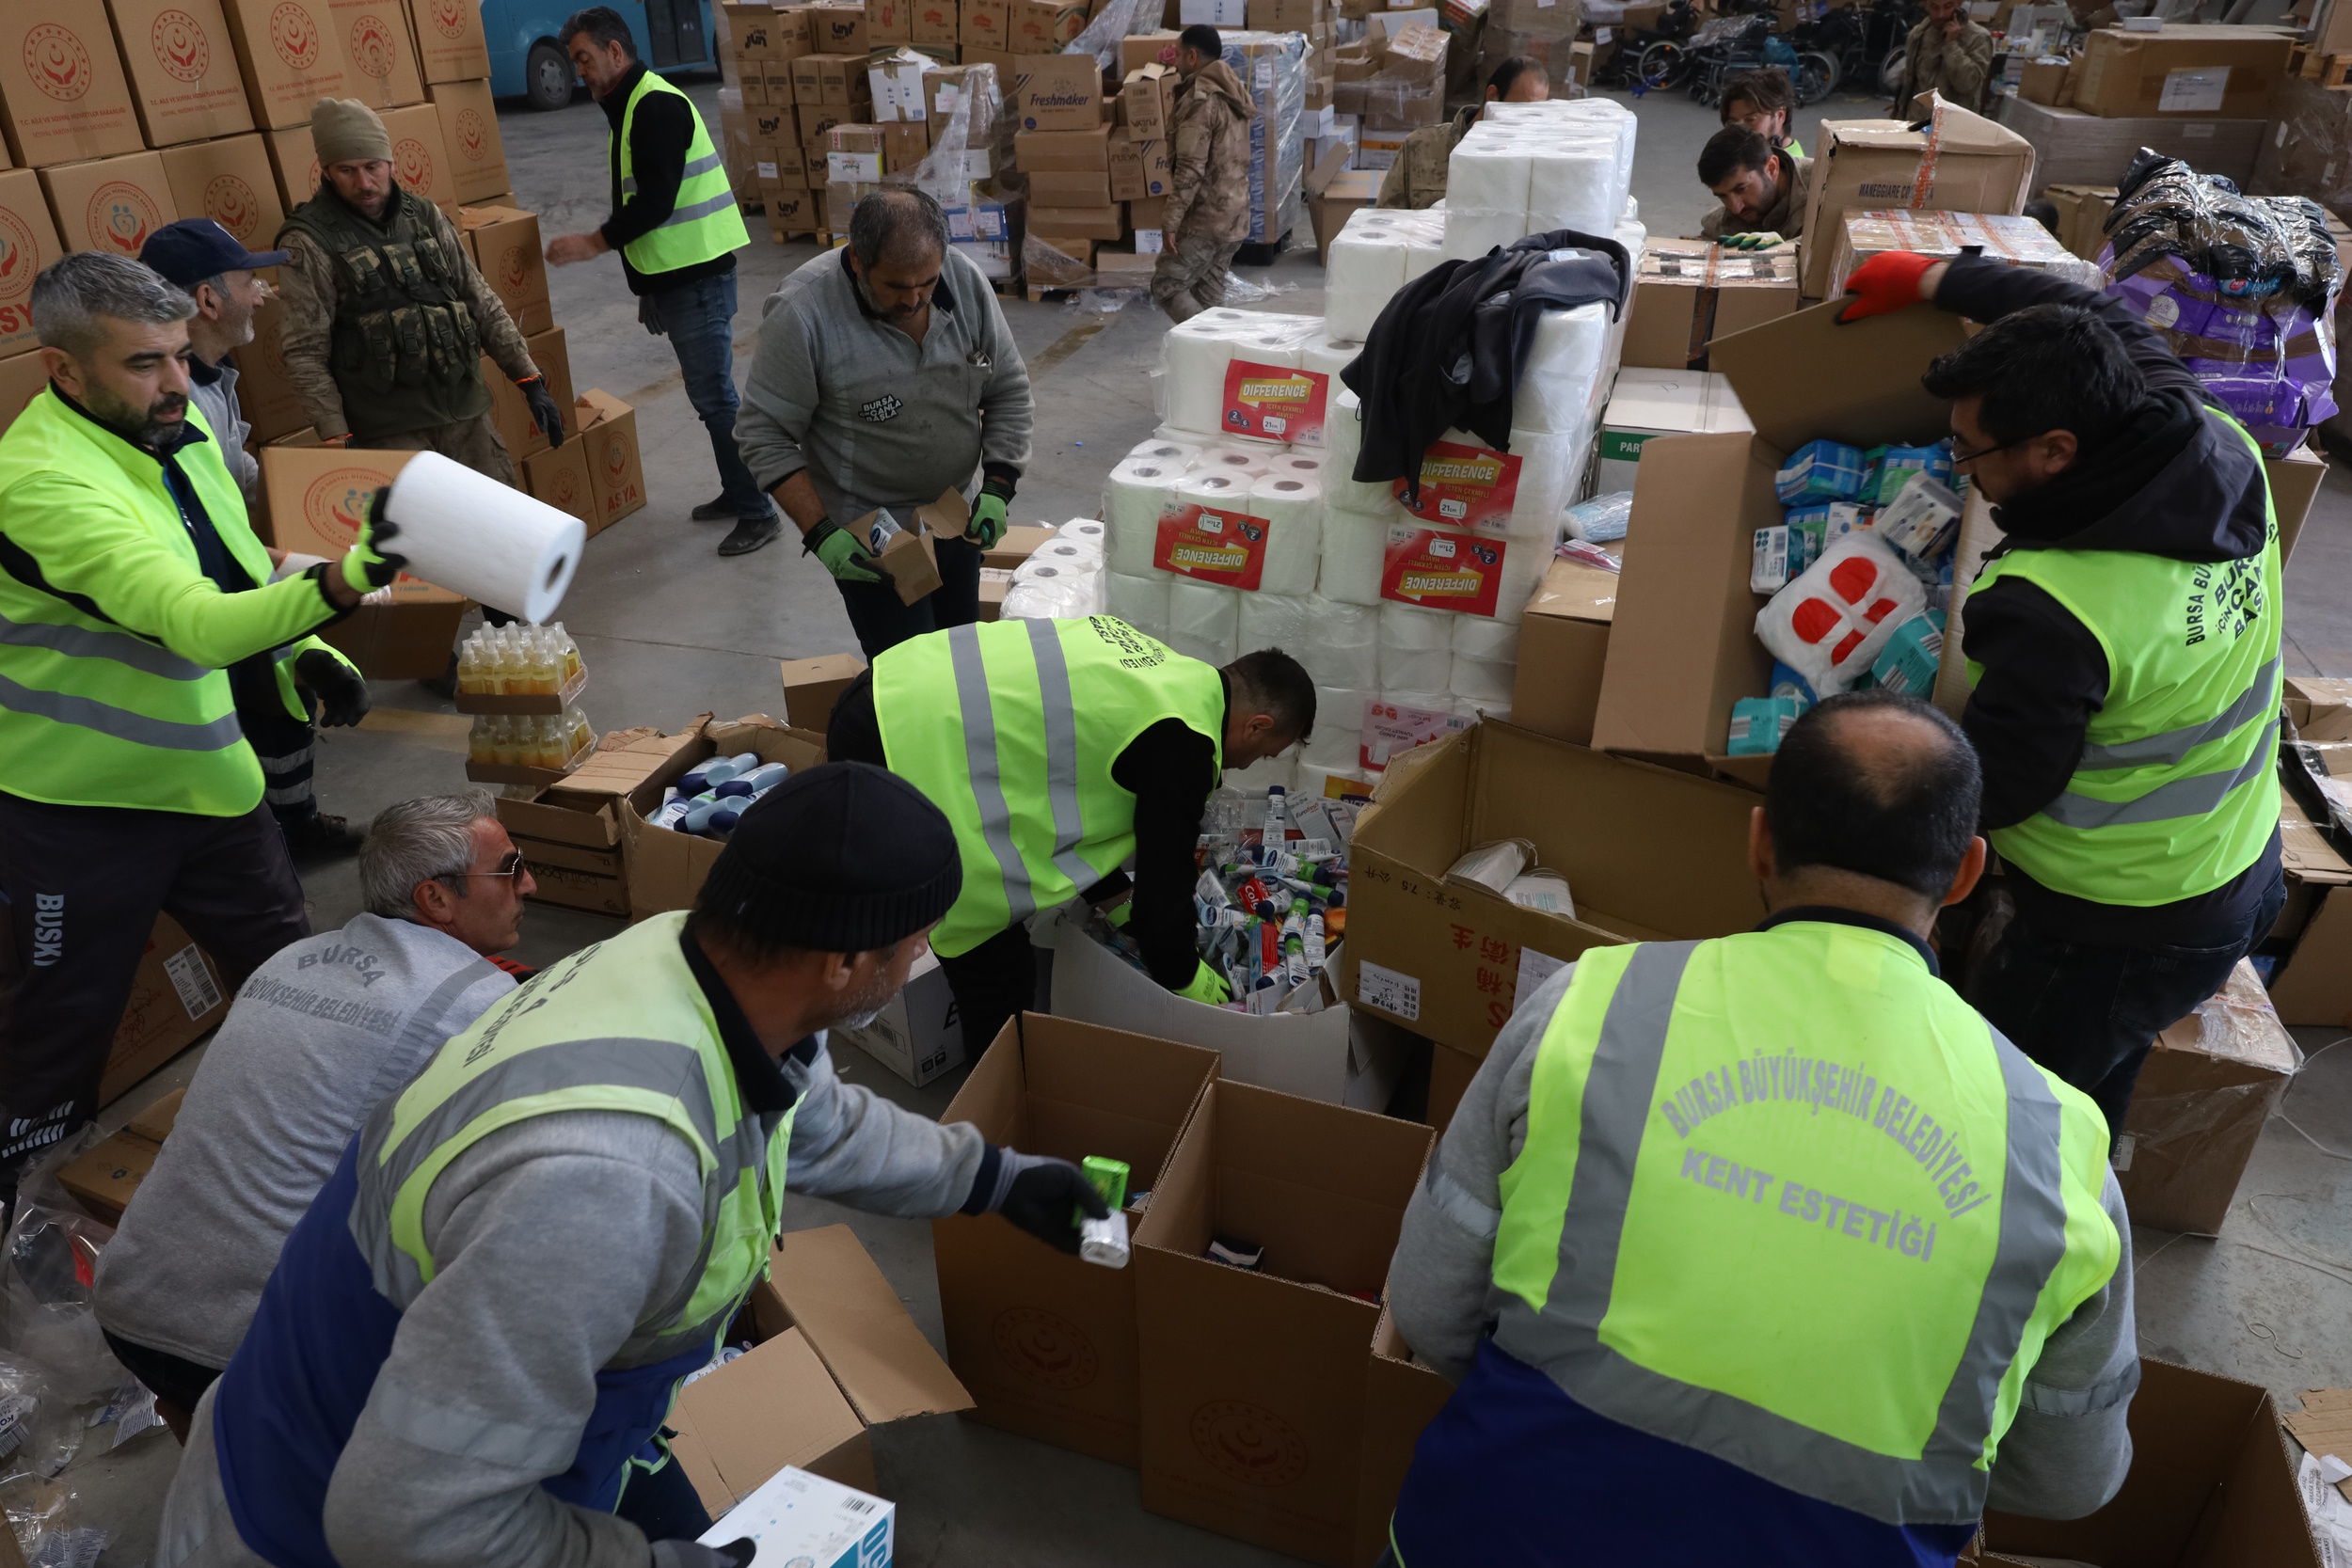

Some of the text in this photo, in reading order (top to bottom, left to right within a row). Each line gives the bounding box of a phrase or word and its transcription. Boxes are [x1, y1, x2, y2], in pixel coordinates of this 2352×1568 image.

[1030, 93, 1089, 106] Freshmaker
[1859, 183, 1900, 198] MANEGGIARE
[1243, 385, 1307, 398] DIFFERENCE
[863, 395, 894, 411] BURSA
[870, 400, 901, 417] CANLA
[866, 409, 898, 421] BAŞLA
[1620, 442, 1643, 452] PAR
[1422, 463, 1494, 481] DIFFERENCE
[607, 483, 638, 515] ASYA
[1464, 486, 1490, 499] ÇEKMELİ
[1176, 548, 1244, 566] DIFFERENCE
[1405, 577, 1478, 591] DIFFERENCE
[2185, 594, 2206, 647] BURSA
[1295, 802, 1319, 818] Eurofresh
[298, 944, 385, 988] BURSA
[244, 975, 403, 1036] BÜYÜKŞEHİR BELEDİYESİ
[1661, 1047, 1993, 1220] BURSA BÜYÜKŞEHİR BELEDİYESİ
[1679, 1147, 1938, 1263] KENT ESTETİĞİ
[0, 1415, 14, 1426] KO
